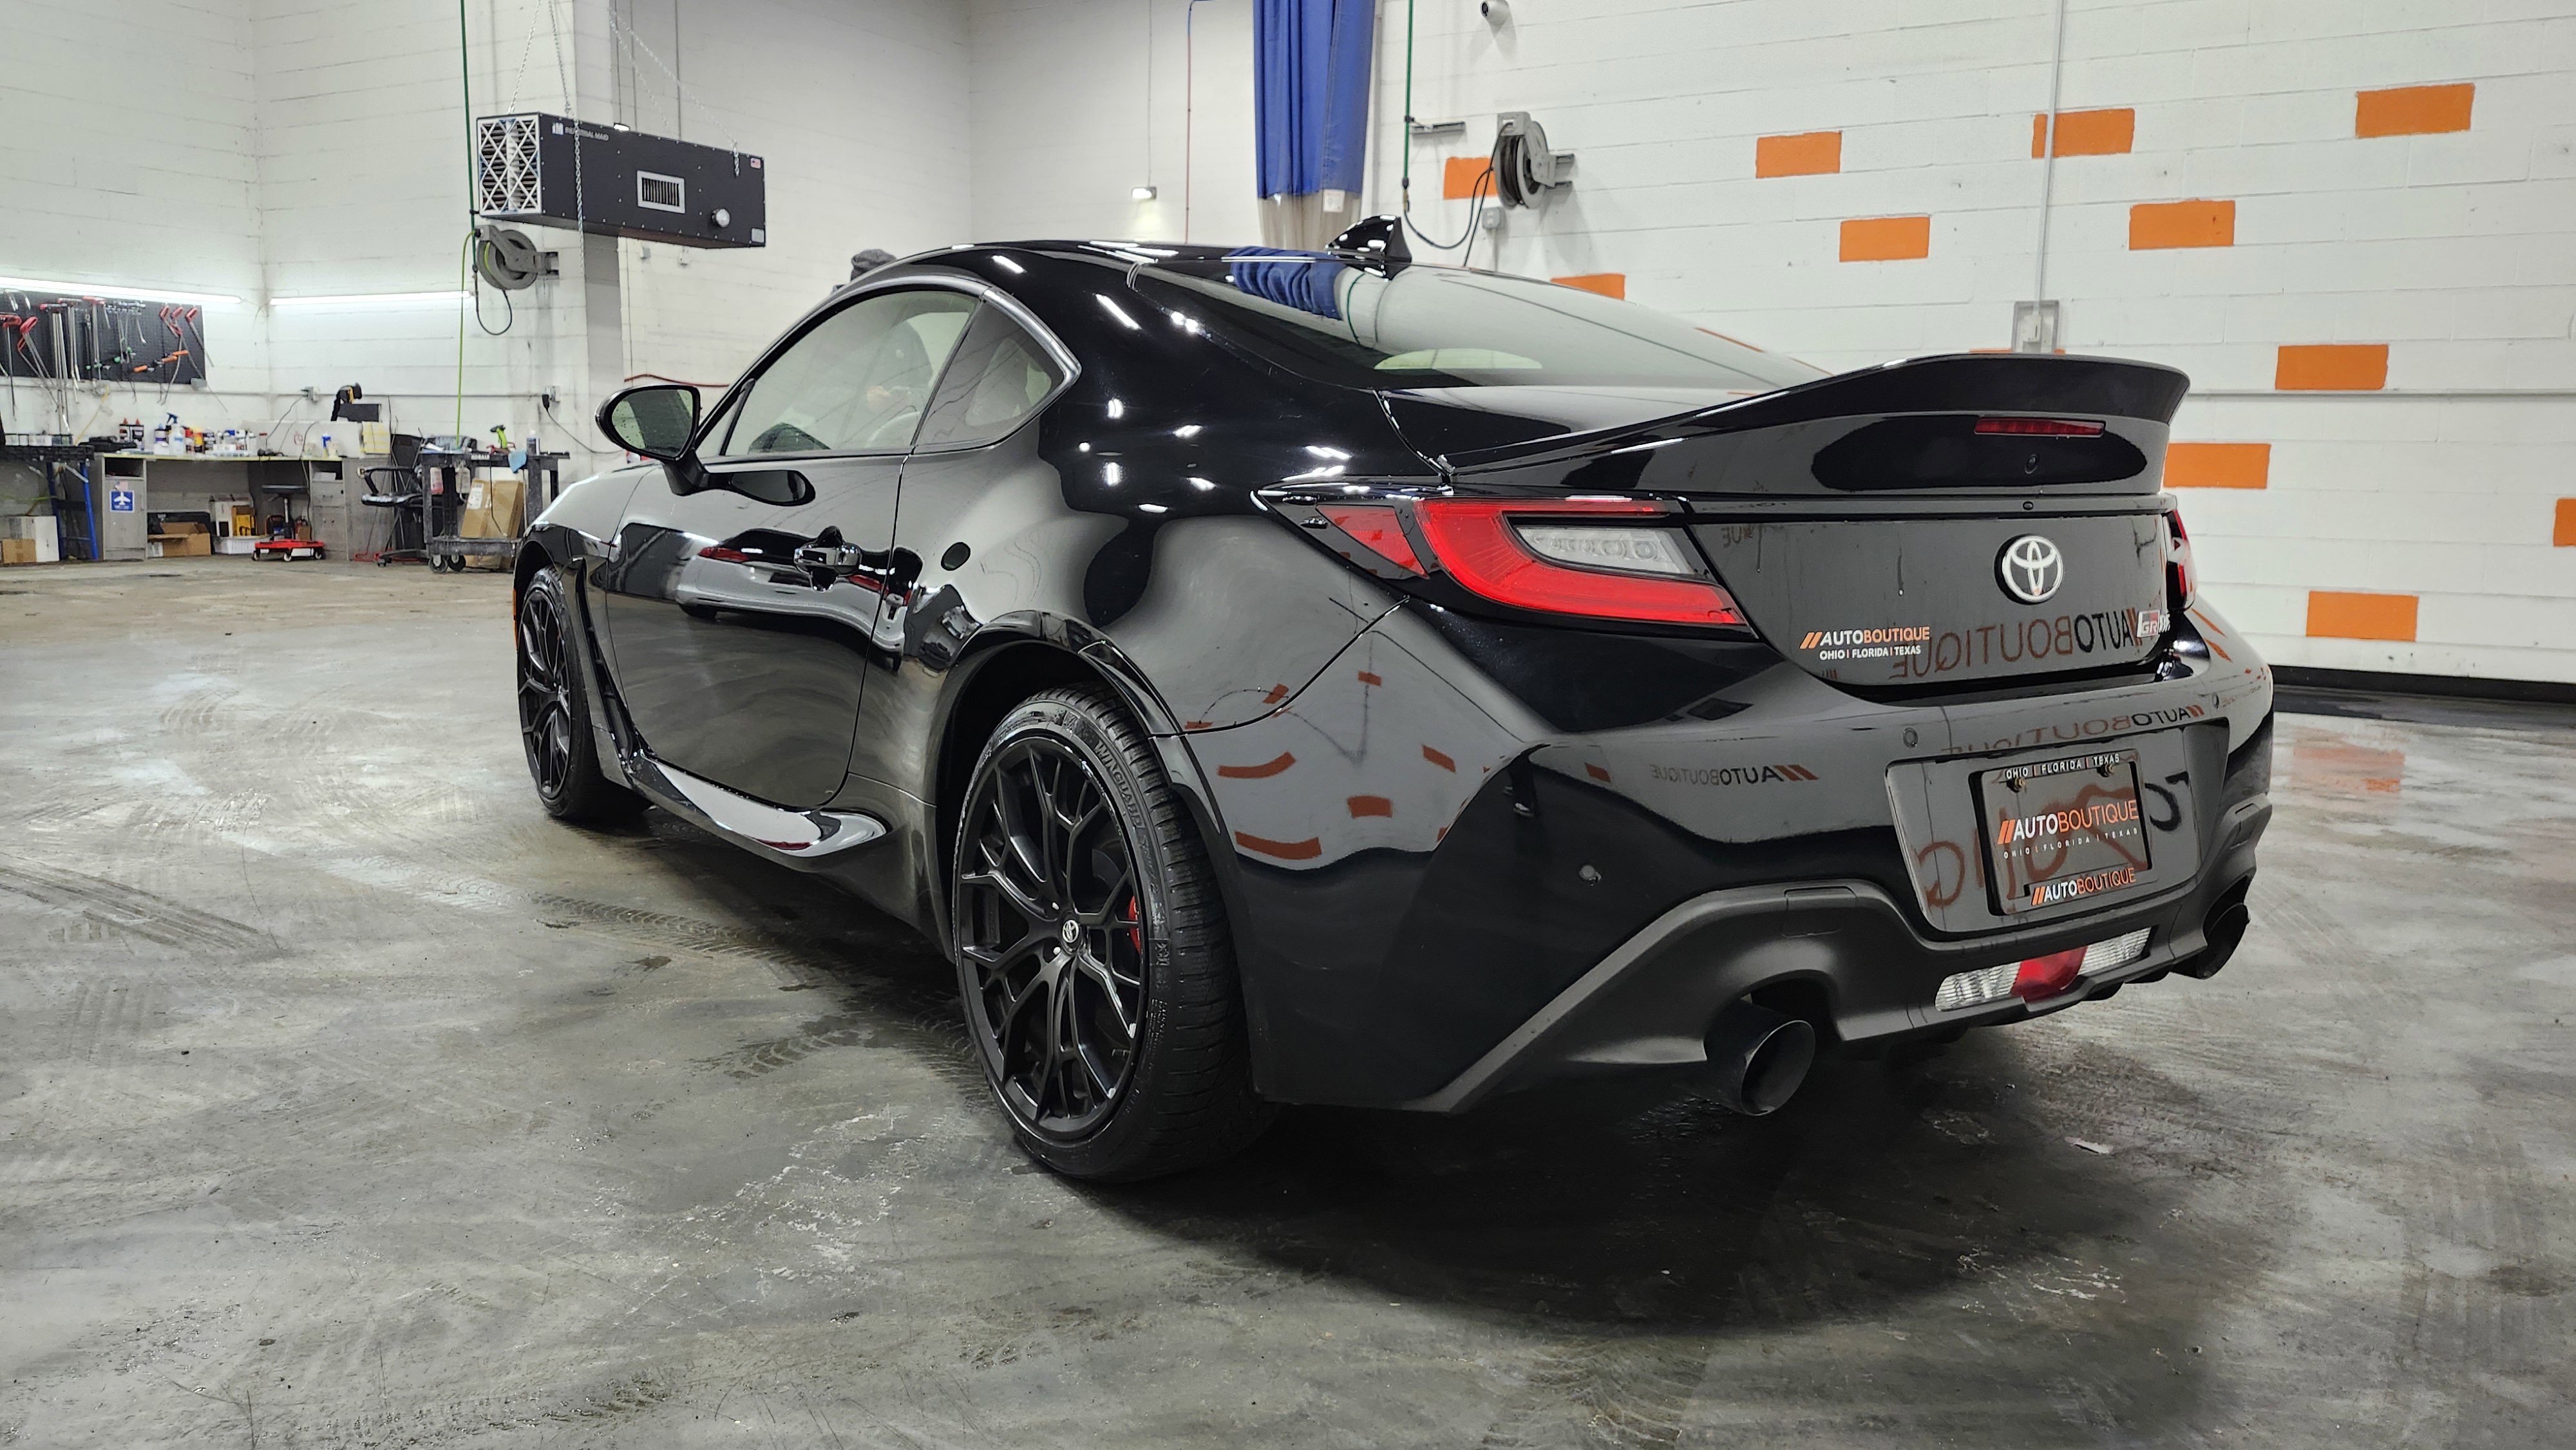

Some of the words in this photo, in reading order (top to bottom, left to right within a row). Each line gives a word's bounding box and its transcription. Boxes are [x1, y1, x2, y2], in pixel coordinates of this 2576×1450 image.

[1819, 626, 1931, 646] AUTOBOUTIQUE
[1819, 650, 1845, 661] OHIO
[1852, 647, 1889, 659] FLORIDA
[1894, 645, 1921, 656] TEXAS
[2005, 767, 2029, 779] OHIO
[2041, 761, 2082, 774] FLORIDA
[2093, 753, 2120, 766] TEXAS
[1094, 740, 1146, 829] WINGUARD
[2013, 799, 2139, 841] AUTOBOUTIQUE
[2003, 847, 2030, 859] OHIO
[2043, 836, 2090, 851] FLORIDA
[2105, 827, 2138, 840] TEXAS
[2043, 867, 2137, 903] AUTOBOUTIQUE
